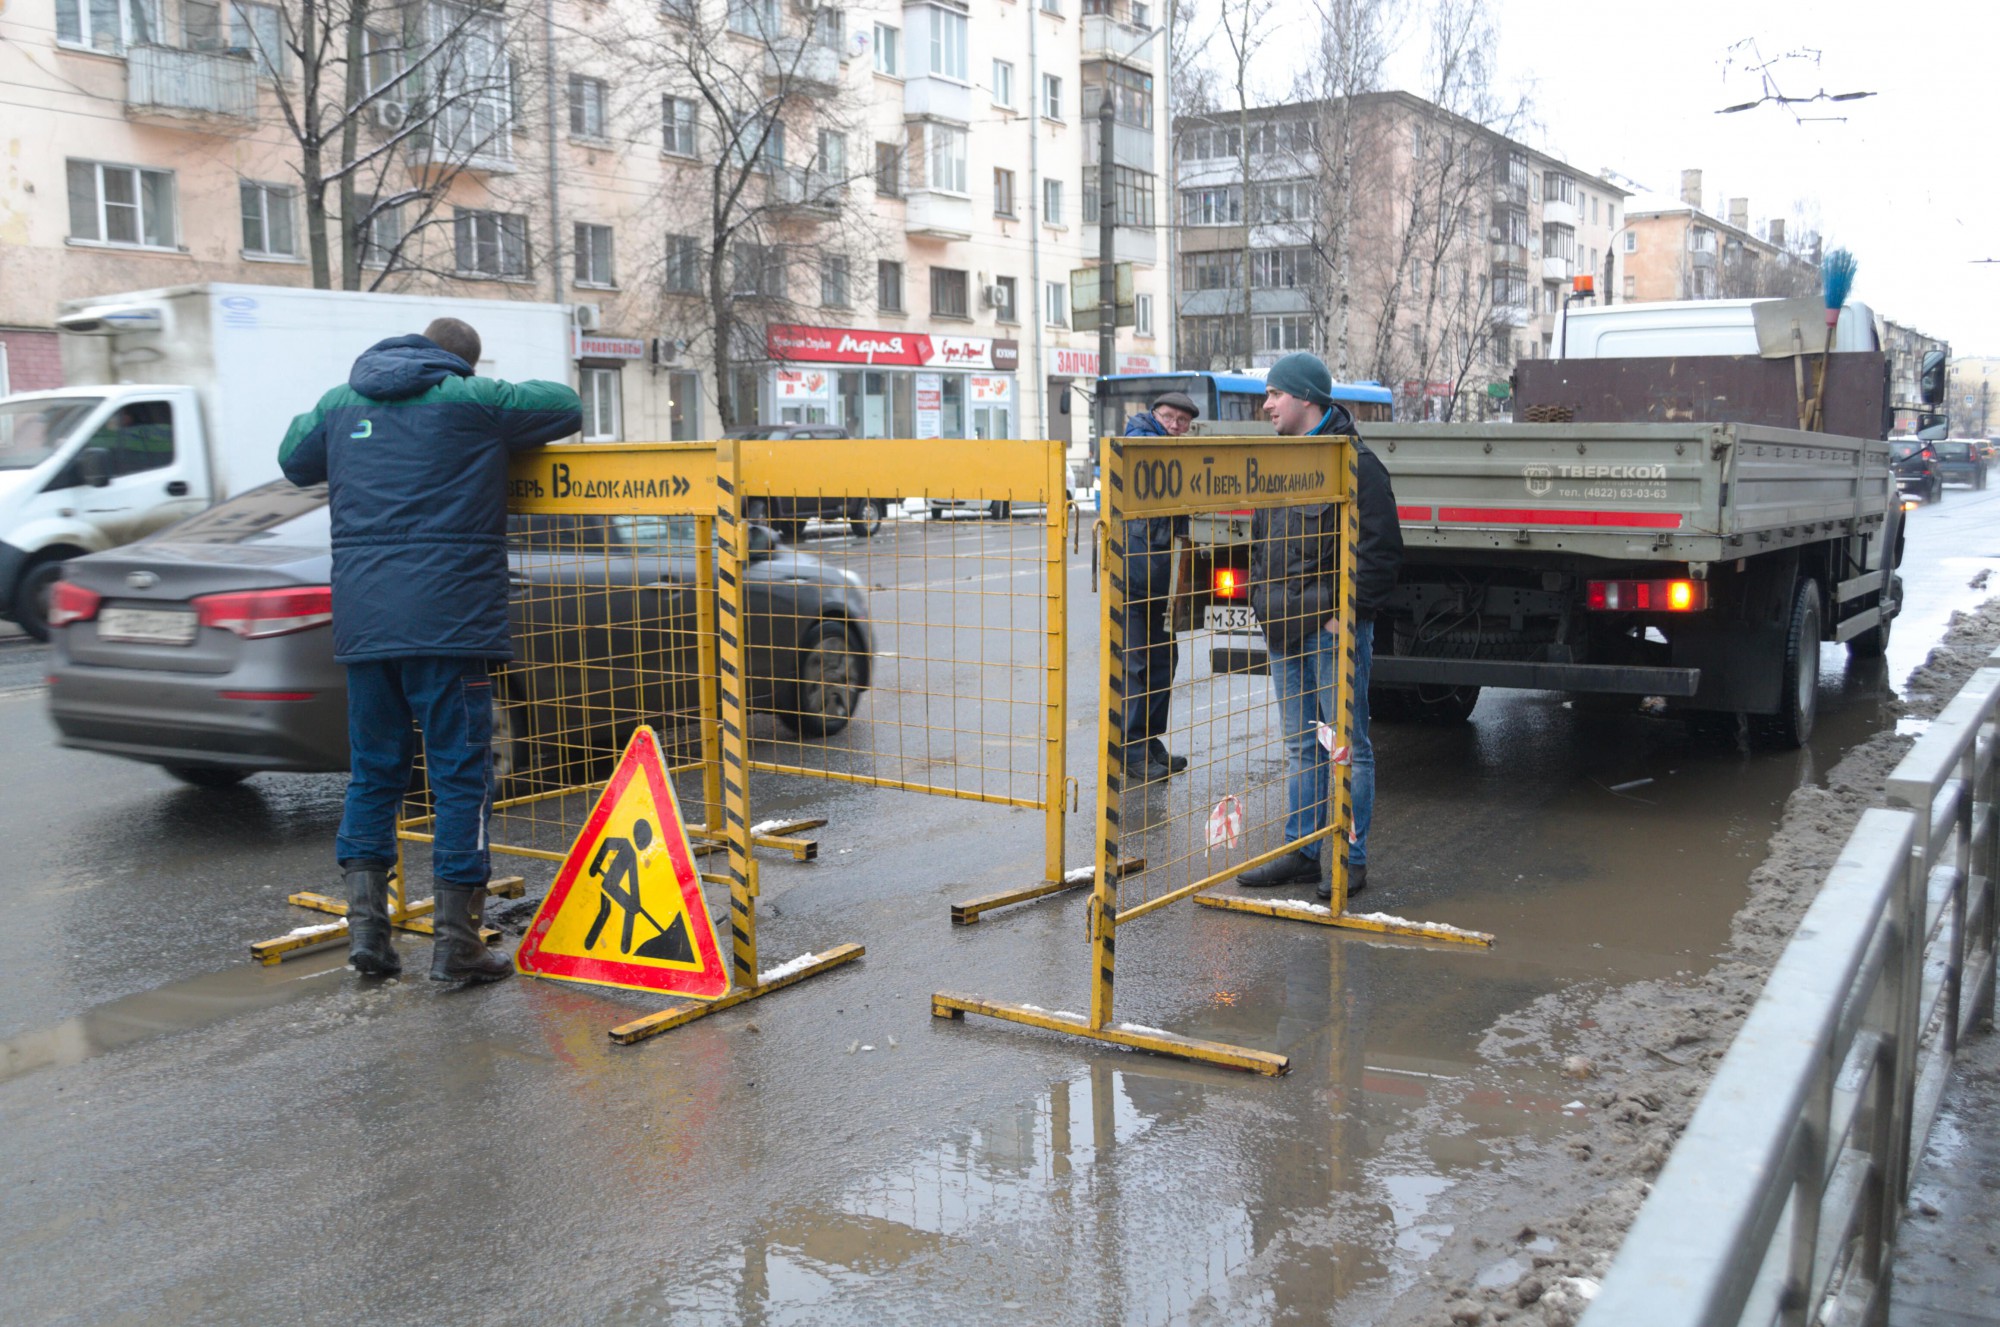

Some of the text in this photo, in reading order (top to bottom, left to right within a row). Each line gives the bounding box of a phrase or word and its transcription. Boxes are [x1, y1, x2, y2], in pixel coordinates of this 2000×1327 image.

[1057, 351, 1100, 374] ЗАПЧАС
[1558, 463, 1667, 479] ТВЕРСКОЙ
[507, 479, 544, 498] ВЕРЬ
[1559, 487, 1667, 500] тел. (4822) 63-03-63
[1212, 609, 1259, 629] М331
